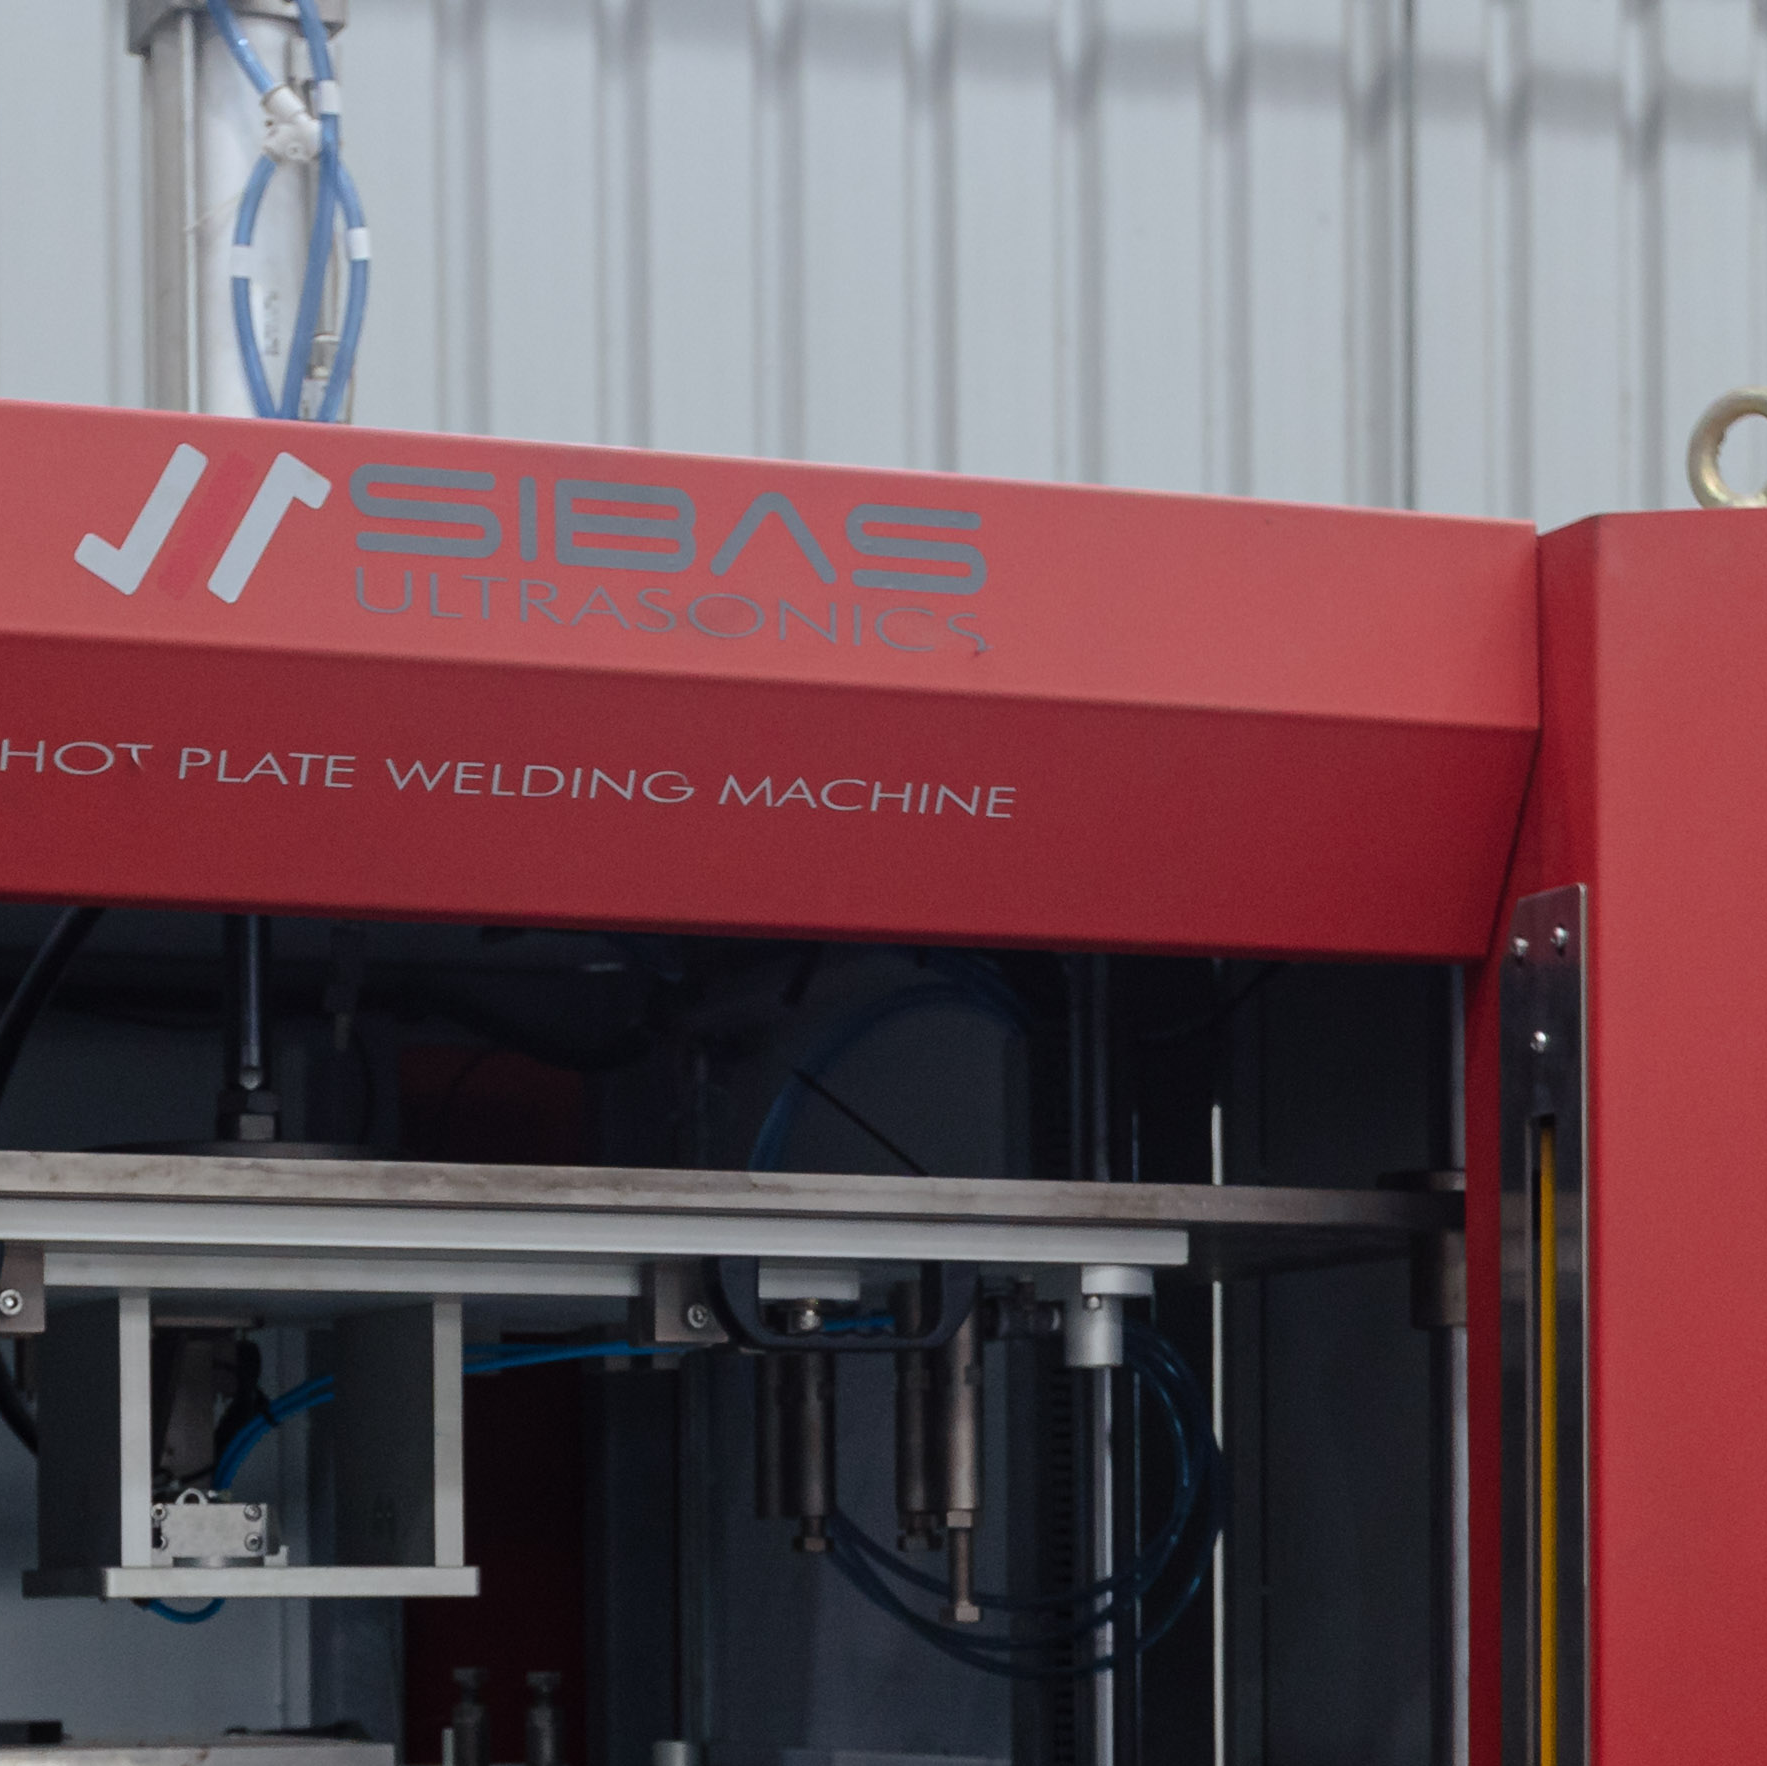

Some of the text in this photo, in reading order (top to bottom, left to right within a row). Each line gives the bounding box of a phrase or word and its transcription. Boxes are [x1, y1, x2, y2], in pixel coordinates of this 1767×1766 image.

[349, 463, 987, 595] SIBAS
[355, 566, 994, 656] ULTRASONICS
[0, 738, 1017, 818] HOT PLATE WELDING MACHINE
